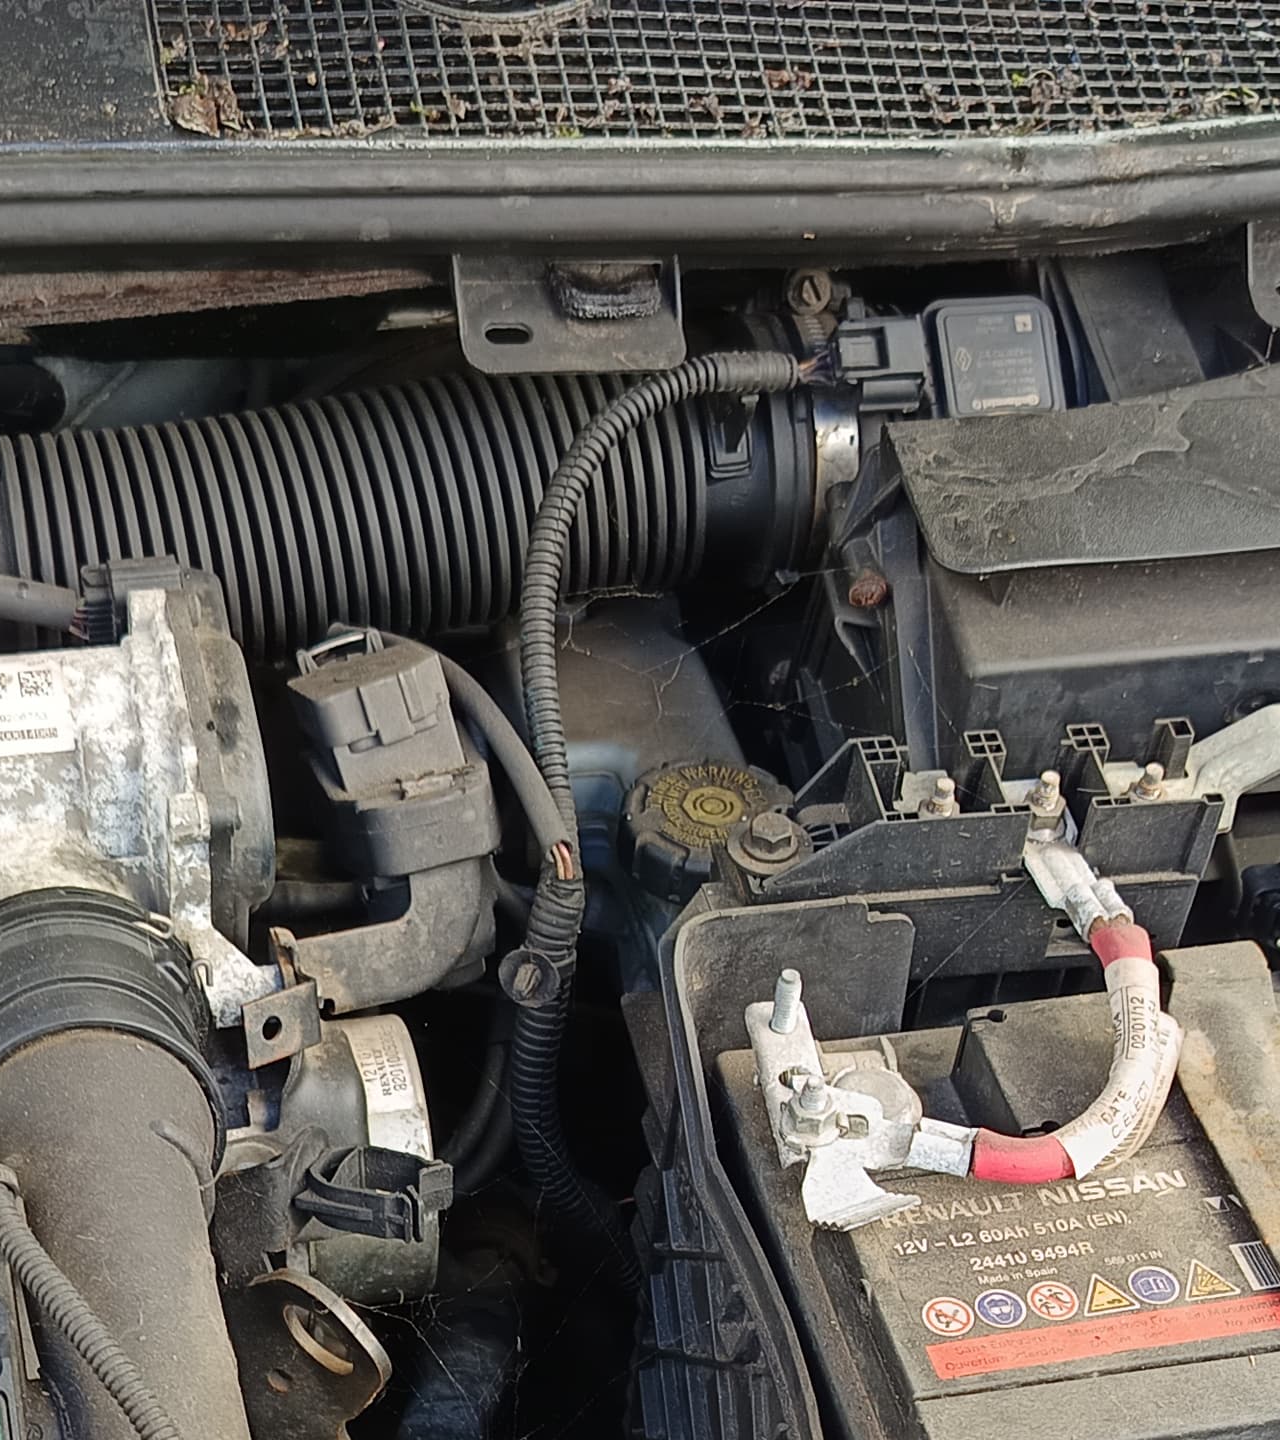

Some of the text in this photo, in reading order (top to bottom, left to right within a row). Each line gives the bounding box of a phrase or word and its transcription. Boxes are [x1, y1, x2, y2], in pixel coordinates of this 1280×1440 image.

[682, 766, 758, 788] WARNING
[1130, 996, 1146, 1050] 02/01/12
[881, 1170, 1187, 1229] RENAULT NISSAN
[893, 1238, 928, 1256] 12V
[949, 1232, 977, 1247] L2
[979, 1225, 1030, 1243] 60Ah
[1033, 1217, 1084, 1236] 510A
[1031, 1241, 1095, 1262] 9494R
[977, 1266, 1058, 1286] Made in Spain
